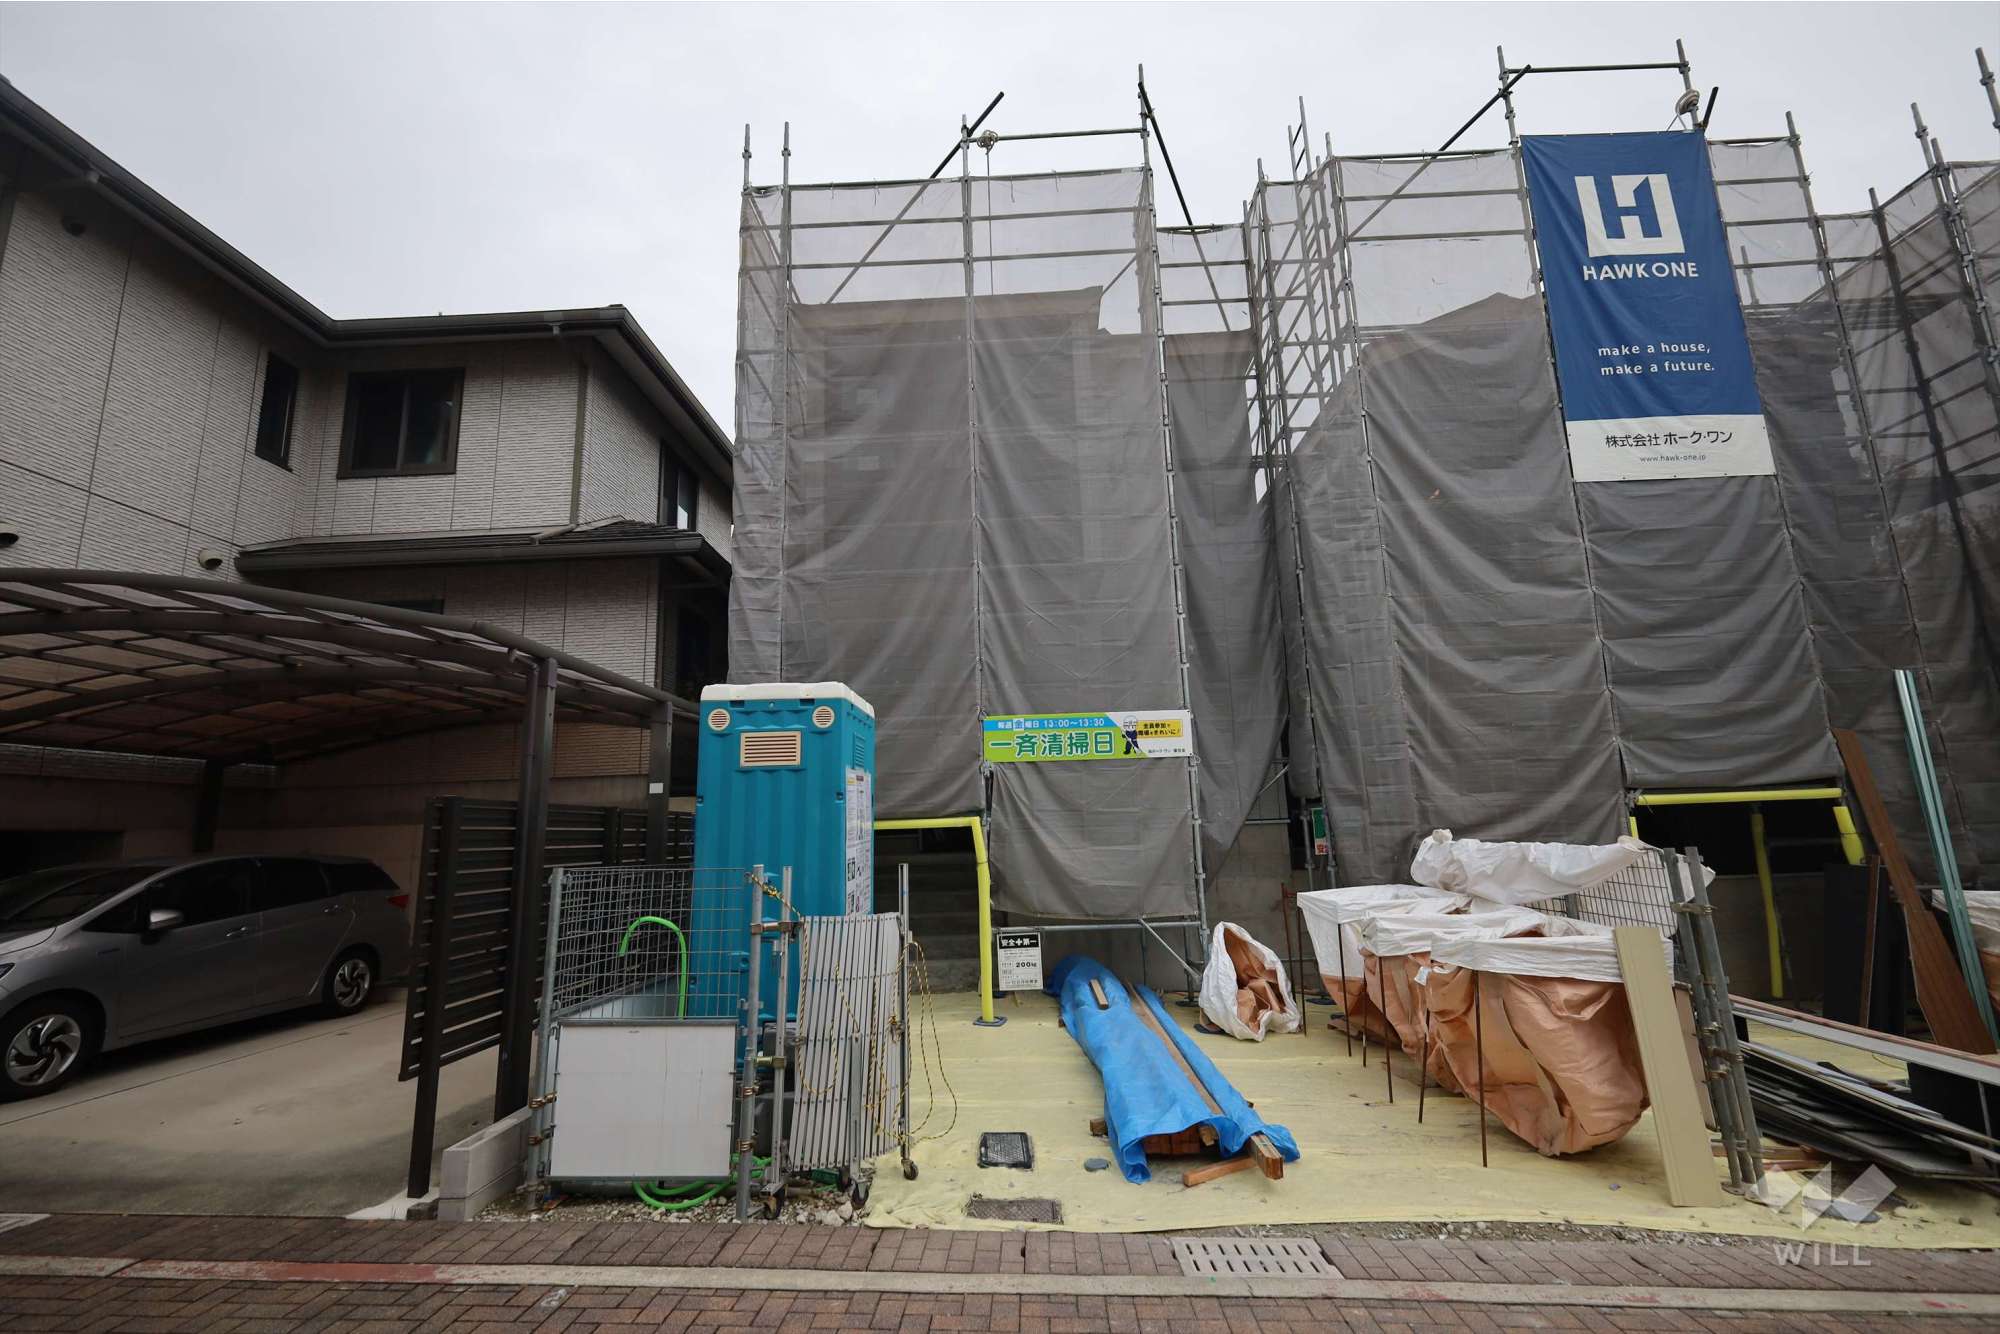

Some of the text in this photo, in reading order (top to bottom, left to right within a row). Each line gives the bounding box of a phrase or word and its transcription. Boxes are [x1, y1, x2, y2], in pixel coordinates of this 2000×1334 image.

[1598, 342, 1711, 356] make a house,
[1601, 360, 1715, 375] make a future.
[1640, 454, 1706, 463] www.hawk-one.jp
[989, 731, 1115, 757] 一斉清掃日
